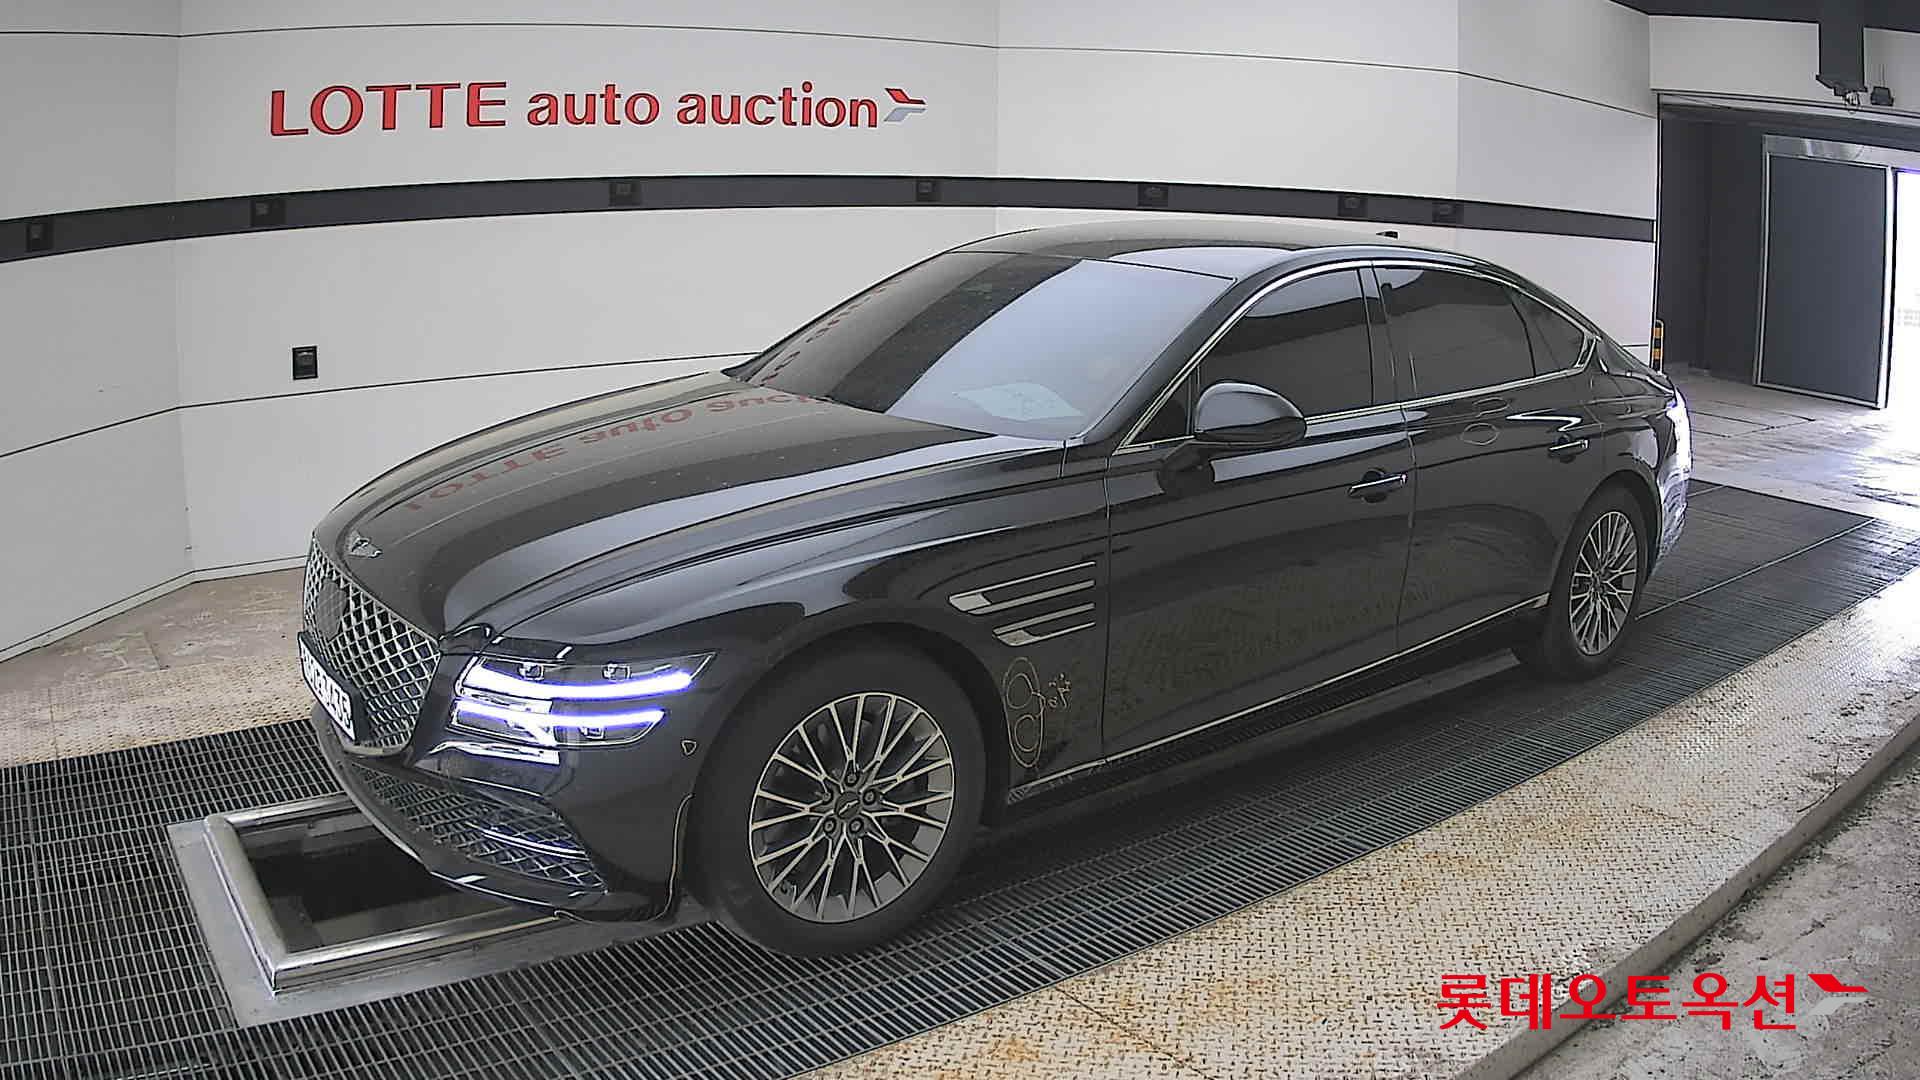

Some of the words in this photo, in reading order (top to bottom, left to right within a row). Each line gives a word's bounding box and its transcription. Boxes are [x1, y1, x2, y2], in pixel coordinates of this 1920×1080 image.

[270, 82, 506, 137] LOTTE
[527, 84, 660, 126] auto
[676, 81, 878, 128] auction
